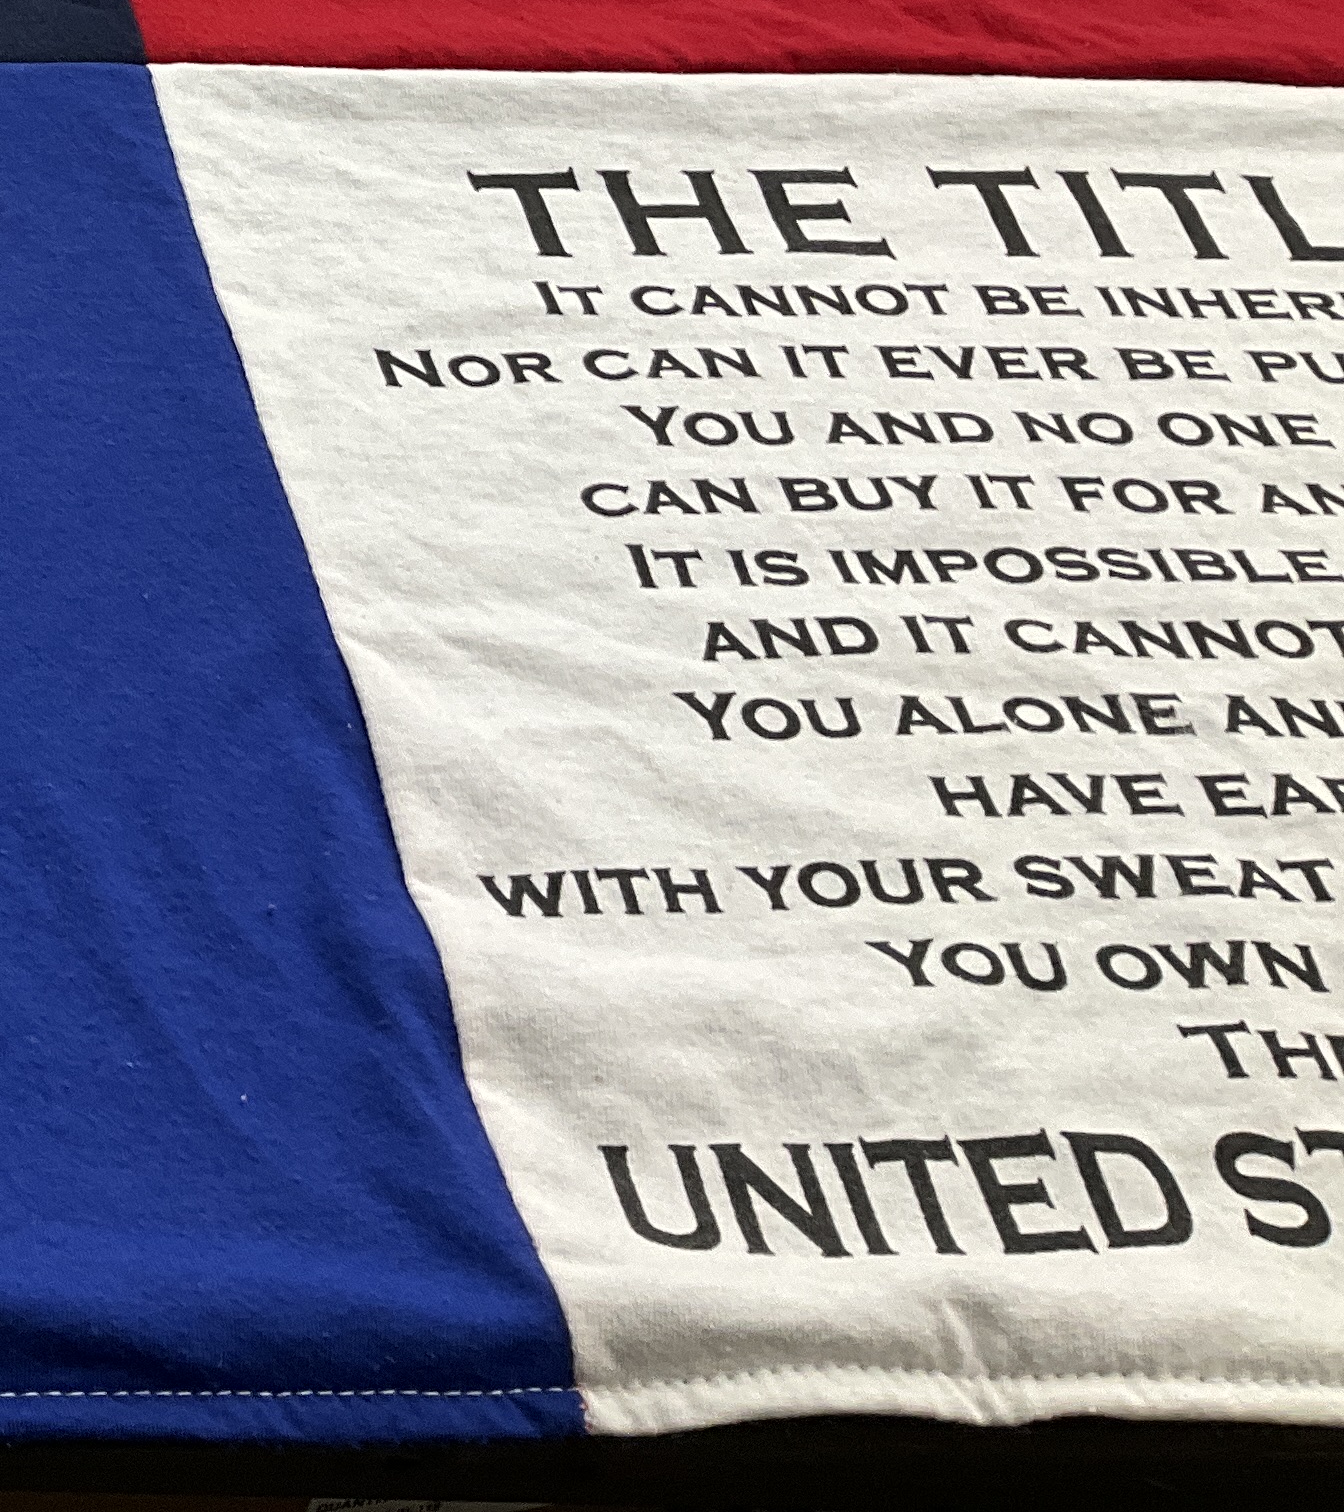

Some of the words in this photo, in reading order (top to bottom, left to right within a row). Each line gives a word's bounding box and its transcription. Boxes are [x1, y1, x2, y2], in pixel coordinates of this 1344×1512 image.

[467, 165, 897, 261] THE
[925, 165, 1344, 264] TITL
[629, 284, 949, 318] CANNOT
[973, 284, 1084, 319] BE
[1108, 285, 1344, 321] INHER
[373, 347, 563, 389] NOR
[582, 345, 762, 382] CAN
[787, 344, 849, 380] IT
[875, 344, 1092, 382] EVER
[1115, 347, 1232, 383] BE
[620, 405, 794, 447] YOU
[826, 410, 996, 445] AND
[1021, 410, 1136, 446] NO
[1156, 411, 1332, 449] ONE
[580, 475, 761, 518] CAN
[781, 473, 940, 514] BUY
[964, 473, 1038, 513] IT
[1064, 476, 1236, 516] FOR
[625, 543, 703, 590] IT
[731, 547, 810, 589] IS
[825, 546, 1344, 585] IMPOSSIBLE
[701, 615, 879, 663] AND
[908, 614, 974, 656] IT
[1003, 616, 1344, 661] CANNOT
[672, 690, 862, 741] YOU
[896, 692, 1197, 738] ALONE
[1224, 693, 1344, 739] AN
[929, 773, 1185, 819] HAVE
[476, 865, 725, 919] WITH
[737, 857, 1006, 912] YOUR
[1013, 853, 1337, 904] SWEAT
[865, 937, 1072, 993] YOU
[1096, 938, 1332, 994] OWN
[1175, 1018, 1344, 1082] TH
[598, 1128, 1195, 1259] UNITED
